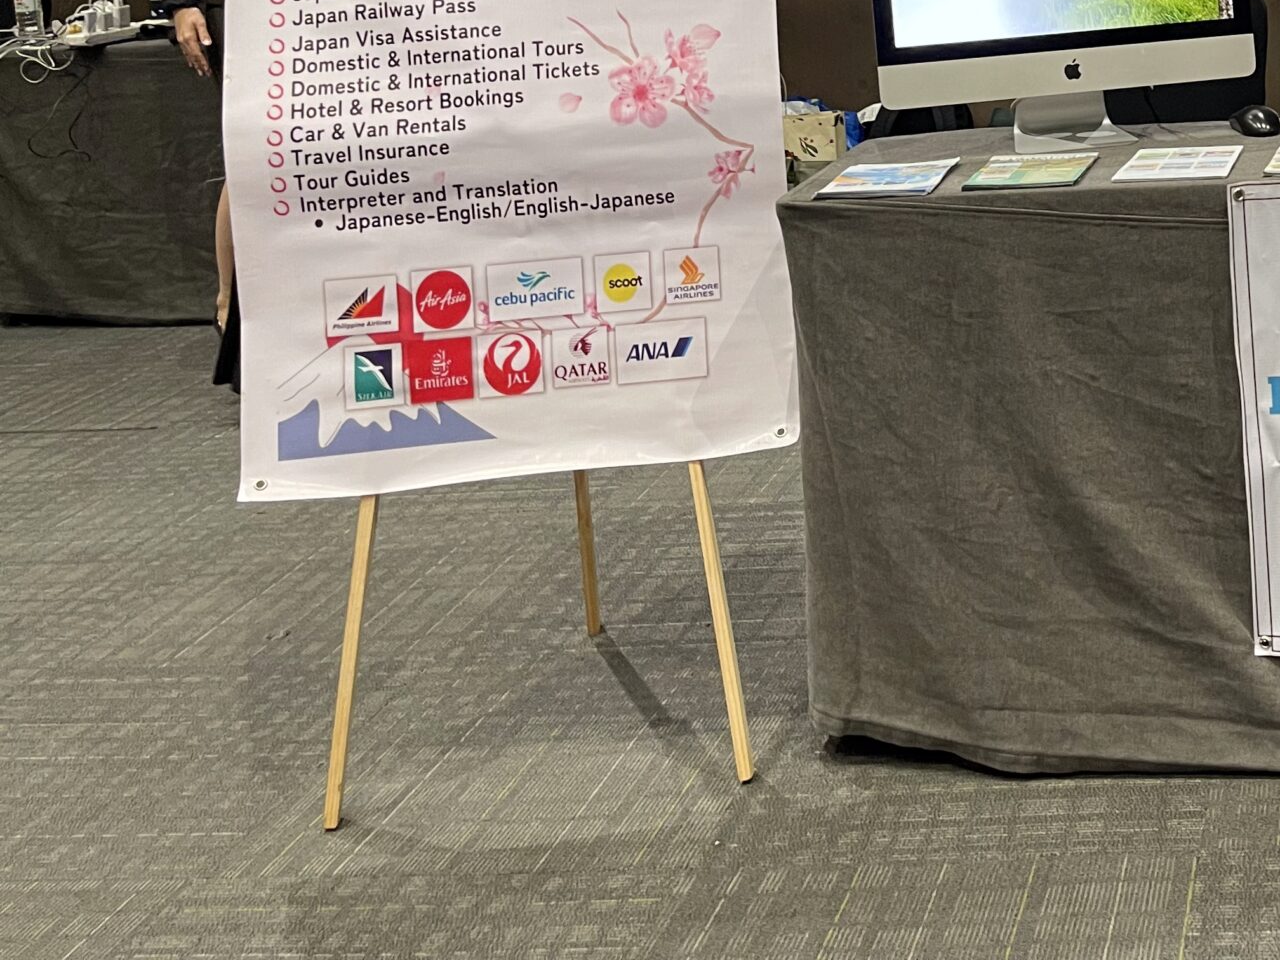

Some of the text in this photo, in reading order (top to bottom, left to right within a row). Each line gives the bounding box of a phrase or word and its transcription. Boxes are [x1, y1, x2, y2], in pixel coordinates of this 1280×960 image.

[292, 9, 348, 28] Japan
[355, 1, 425, 21] Railway
[292, 24, 501, 55] Japan Visa Assistance
[292, 41, 584, 75] Domestic & International Tours
[291, 61, 600, 97] Domestic & International Tickets
[290, 89, 524, 120] Hotel & Resort Bookings
[290, 115, 466, 143] Car & Van Rentals
[291, 142, 450, 166] Travel Insurance
[293, 168, 410, 191] Tour Guides
[300, 178, 558, 213] Interpreter and Translation
[336, 191, 675, 233] Japanese-English/English-Japanese
[609, 275, 643, 289] scoot
[494, 286, 575, 306] cebu pacific
[626, 341, 669, 362] ANA
[415, 374, 468, 390] Emirates
[507, 371, 530, 388] JAL
[554, 361, 608, 381] QATAR
